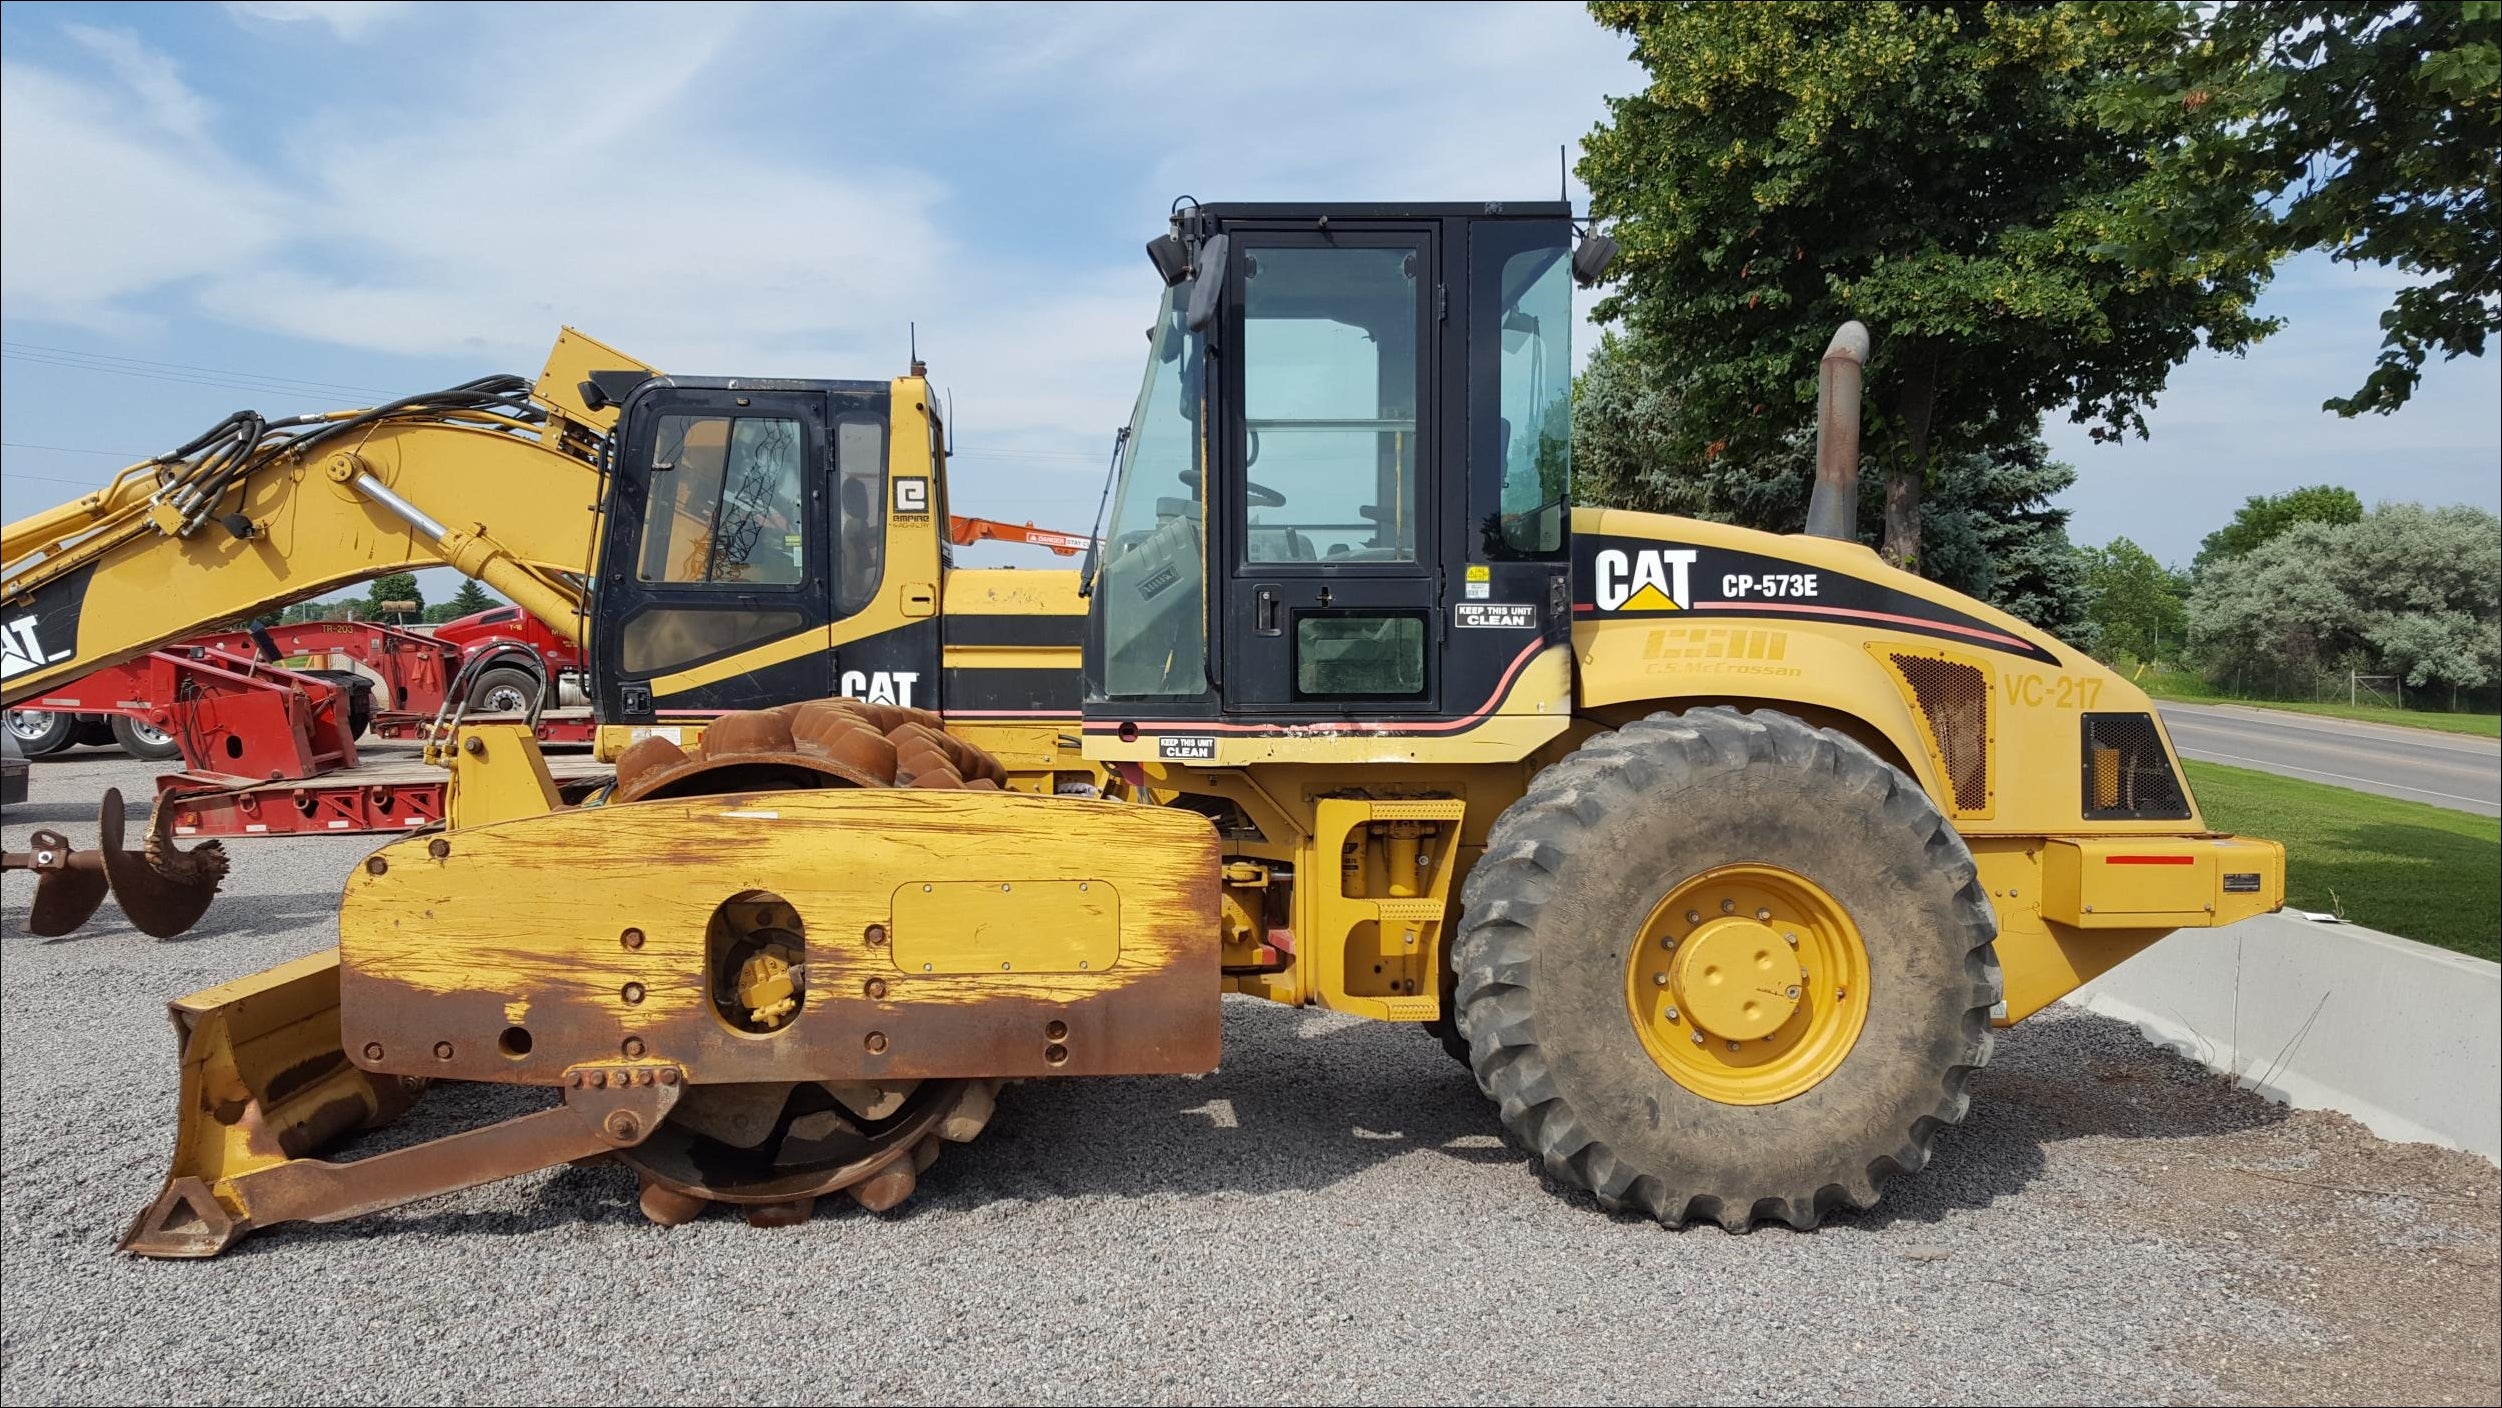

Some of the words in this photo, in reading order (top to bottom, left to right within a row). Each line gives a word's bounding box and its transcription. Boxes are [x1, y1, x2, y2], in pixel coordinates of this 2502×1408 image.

[1038, 536, 1065, 545] DANGER
[1595, 549, 1697, 611] CAT
[1722, 574, 1818, 598] CP-573E
[1459, 606, 1485, 615] KEEP
[1487, 607, 1508, 615] THIS
[1511, 607, 1532, 615] UNIT
[1467, 615, 1525, 626] CLEAN
[321, 625, 353, 634] TR-203
[1, 615, 47, 665] AT
[842, 670, 912, 708] CAT
[2004, 674, 2104, 709] VC-217
[1160, 738, 1179, 747] KEEP
[1180, 739, 1196, 747] THIS
[1197, 739, 1213, 747] UNIT
[1166, 747, 1208, 757] CLEAN
